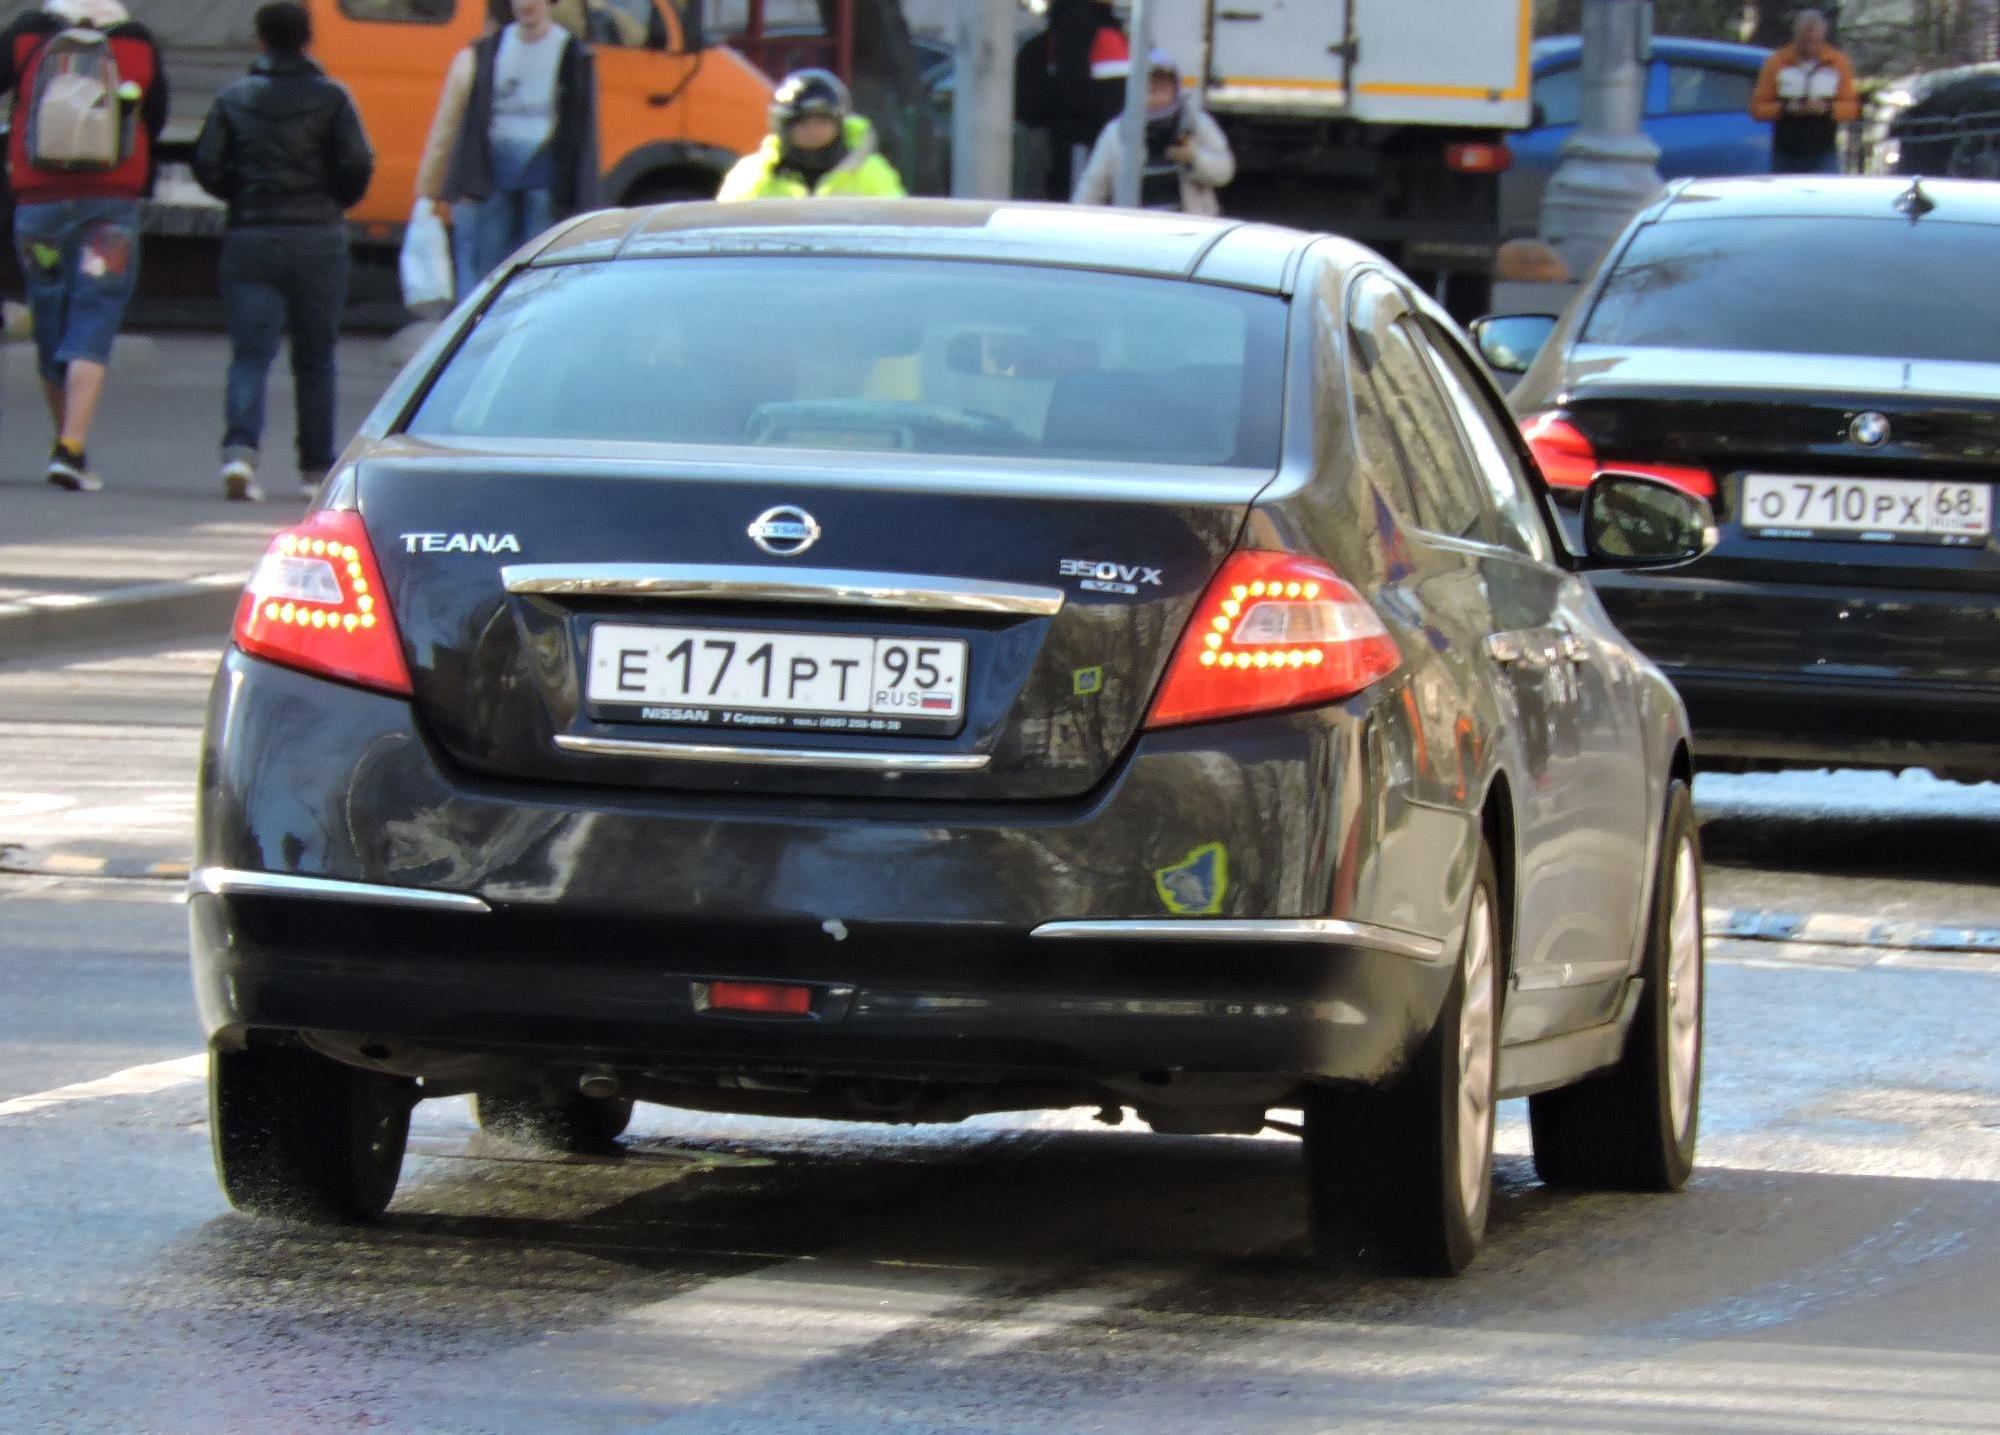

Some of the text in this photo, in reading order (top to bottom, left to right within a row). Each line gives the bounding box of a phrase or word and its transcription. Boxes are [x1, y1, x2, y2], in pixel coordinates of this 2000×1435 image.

[1935, 486, 1973, 516] 68
[399, 533, 521, 554] TEANA
[1058, 559, 1163, 586] 350VX
[882, 645, 942, 689] 95
[875, 690, 921, 708] RUS
[641, 706, 710, 722] NISSAN
